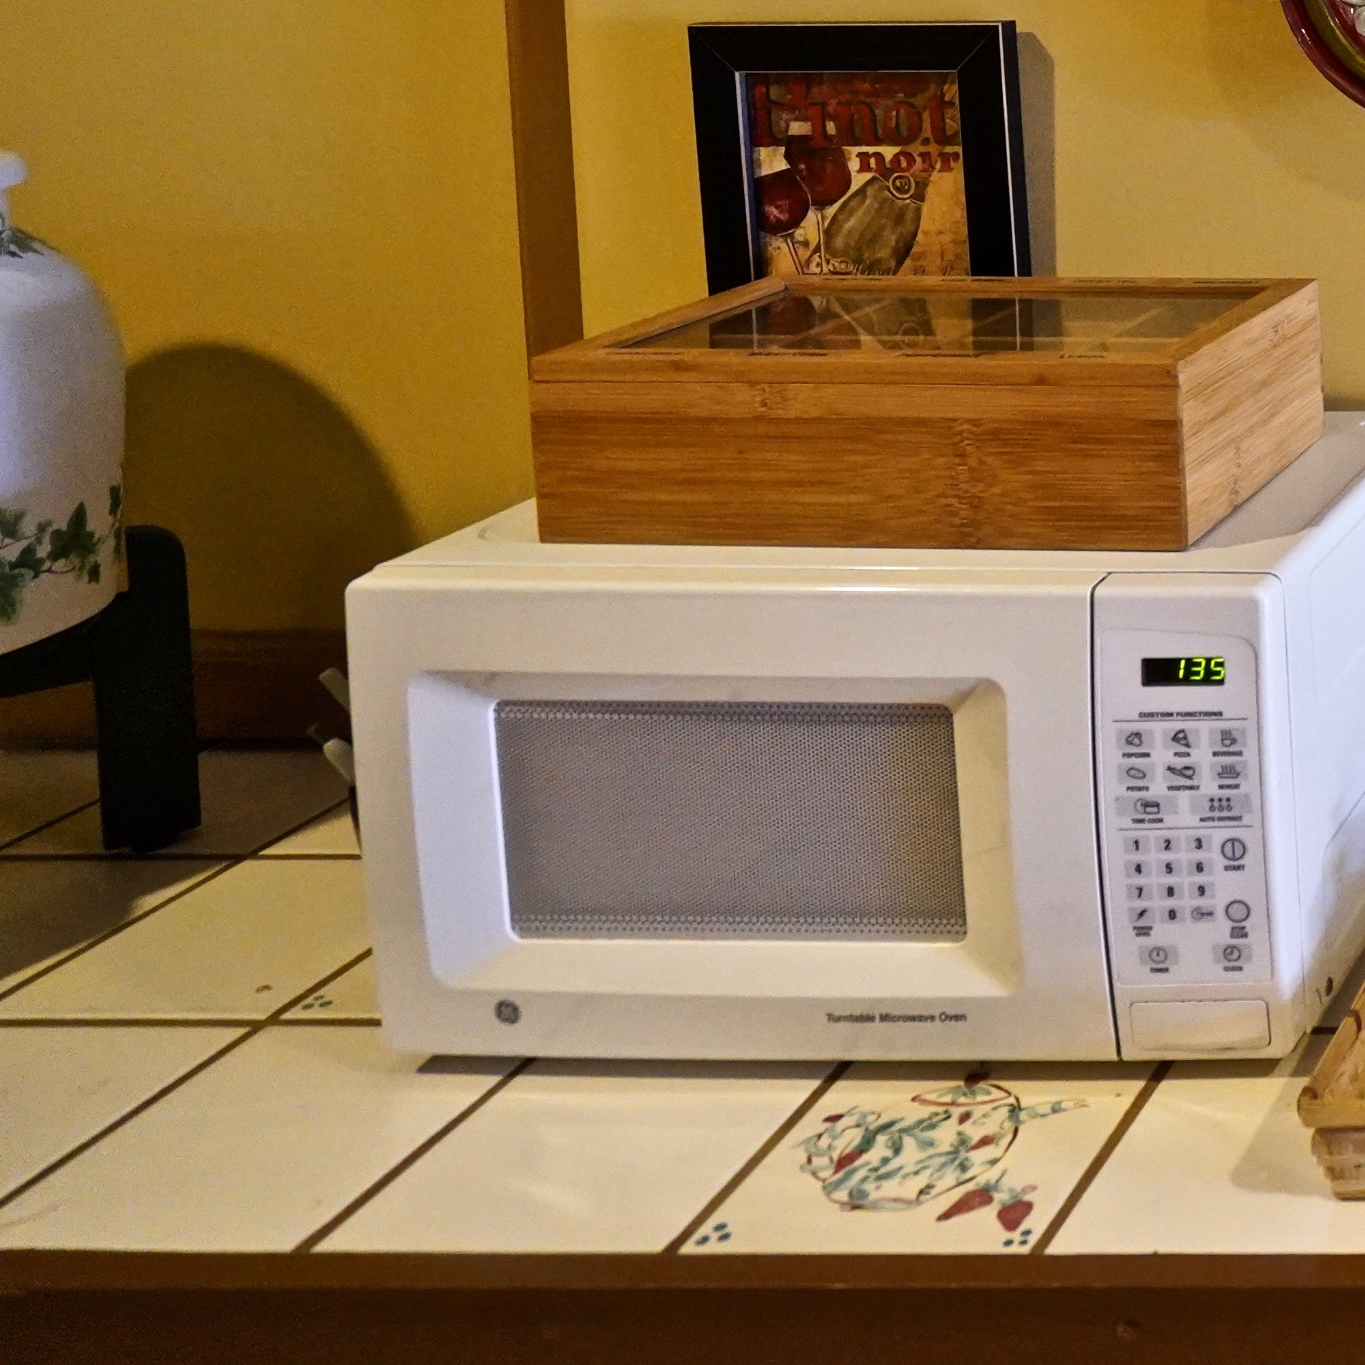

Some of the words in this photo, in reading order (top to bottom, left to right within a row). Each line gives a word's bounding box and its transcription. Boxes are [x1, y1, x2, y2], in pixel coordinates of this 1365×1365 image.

[856, 150, 961, 174] noir
[1133, 839, 1140, 851] 1
[1163, 838, 1172, 851] 2
[1194, 837, 1203, 850] 3
[1134, 863, 1142, 875] 4
[1165, 862, 1173, 874] 5
[1196, 861, 1204, 873] 6
[1136, 886, 1143, 898] 7
[1167, 886, 1175, 897] 8
[1197, 885, 1206, 897] 9
[1168, 909, 1176, 920] 0
[939, 1011, 967, 1022] Oven
